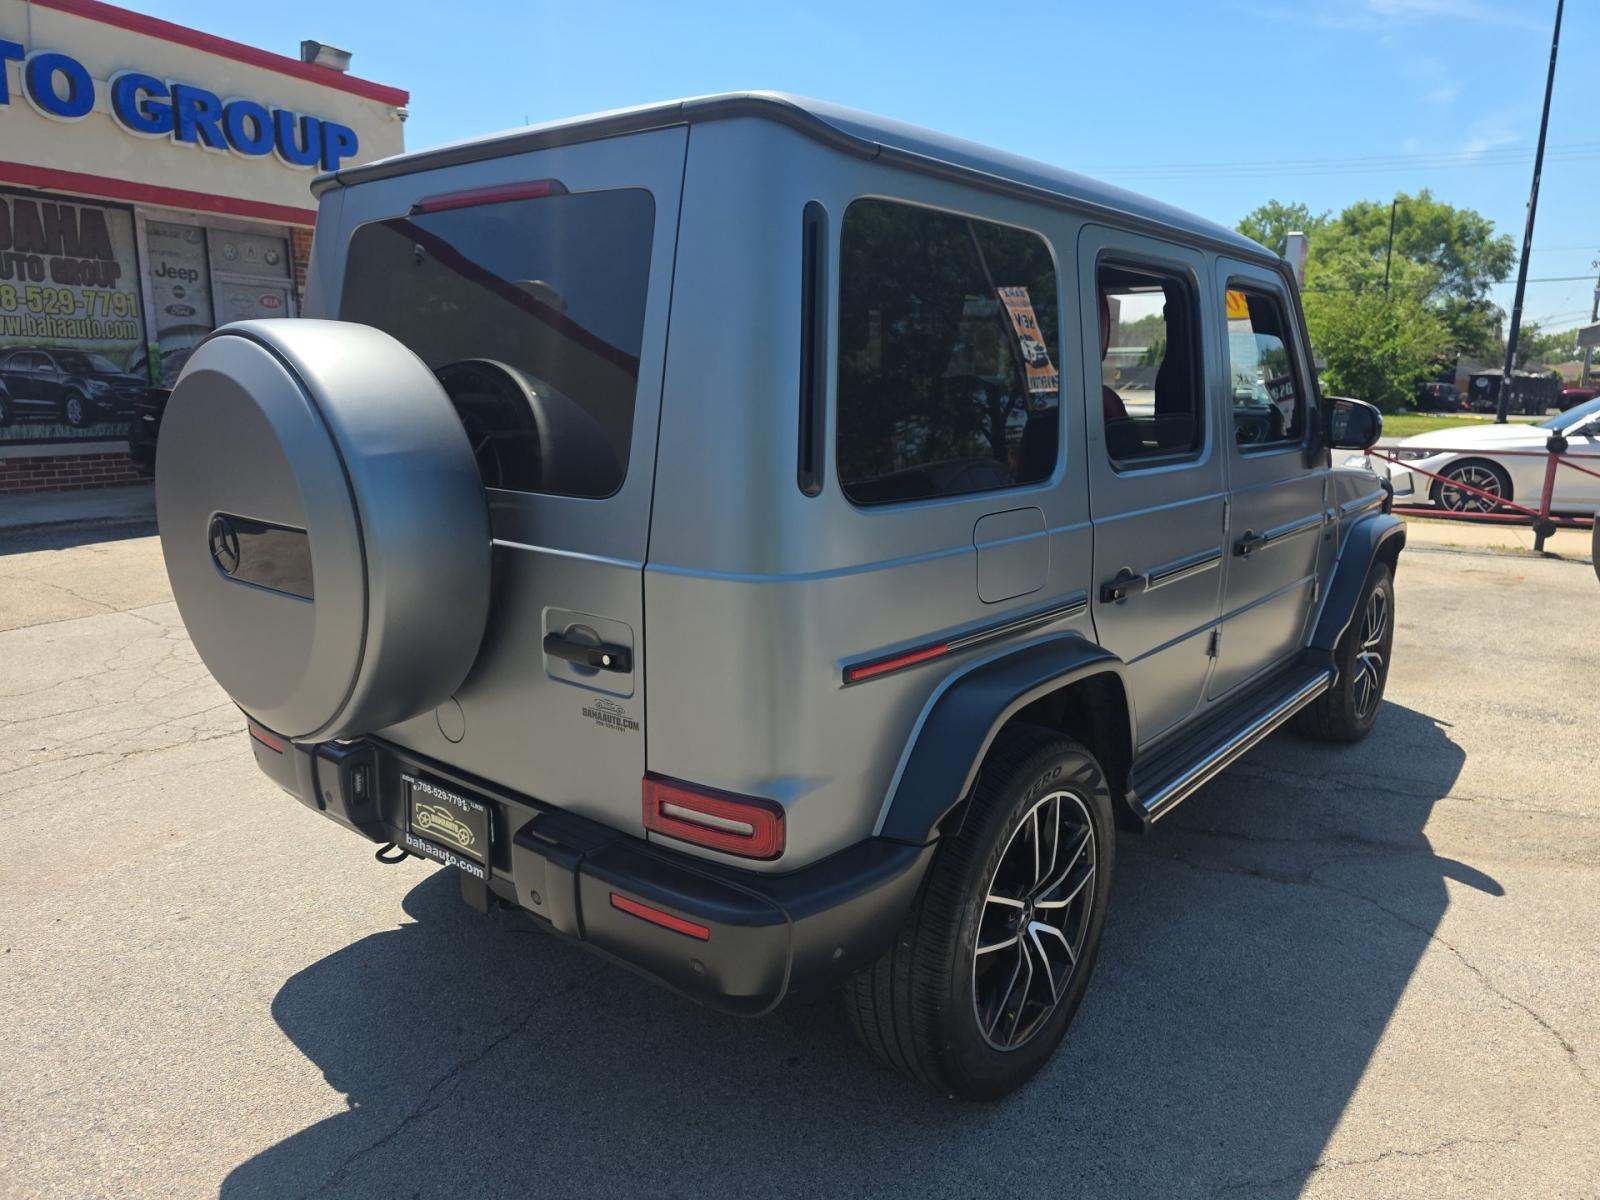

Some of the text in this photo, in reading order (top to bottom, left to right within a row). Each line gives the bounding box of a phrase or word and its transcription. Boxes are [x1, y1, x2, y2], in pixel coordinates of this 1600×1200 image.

[110, 73, 358, 171] GROUP
[50, 257, 121, 289] GROUP
[155, 261, 199, 284] Jeep
[406, 833, 484, 878] bahaauto.com
